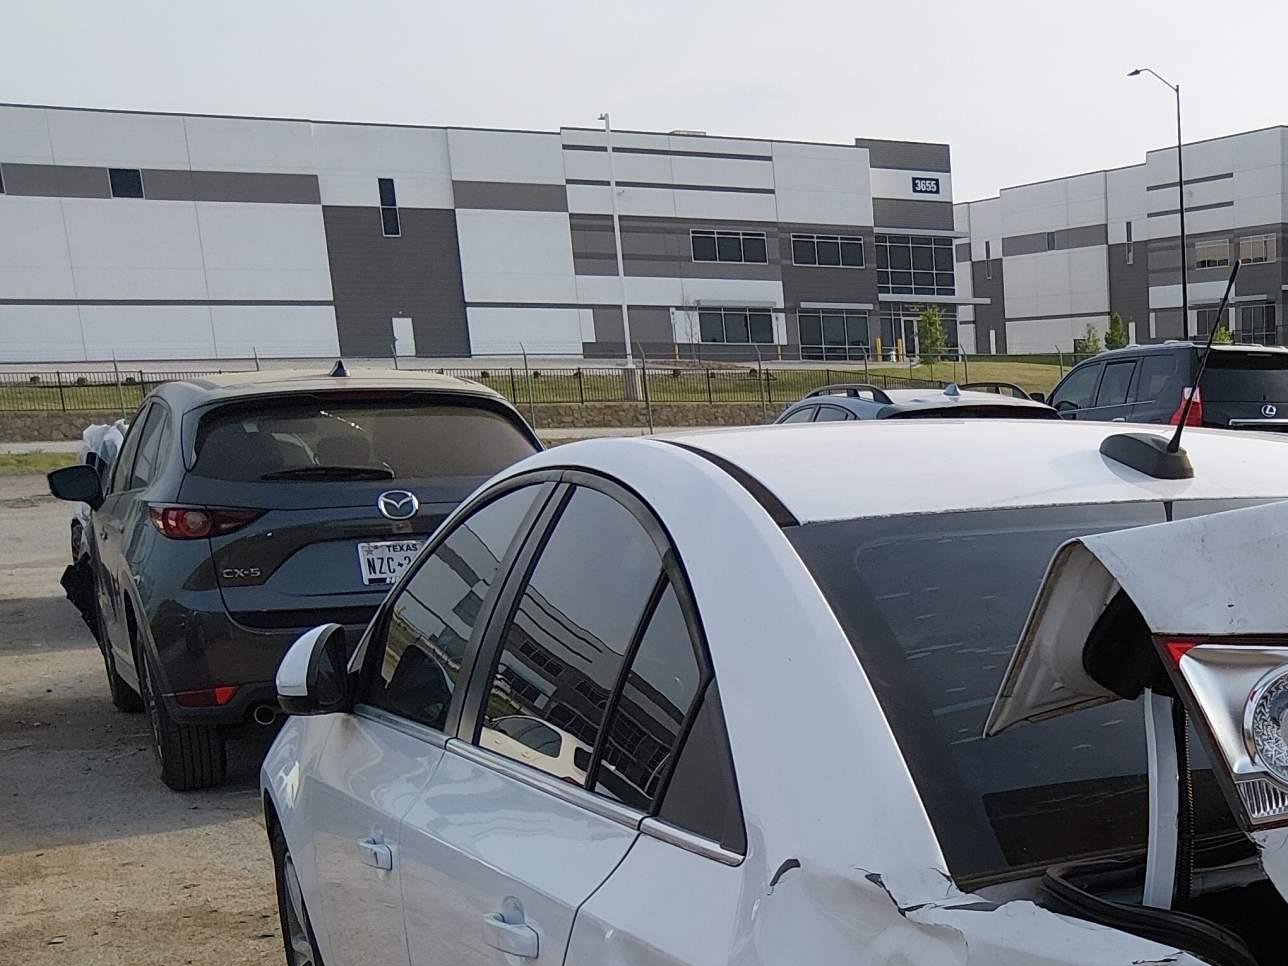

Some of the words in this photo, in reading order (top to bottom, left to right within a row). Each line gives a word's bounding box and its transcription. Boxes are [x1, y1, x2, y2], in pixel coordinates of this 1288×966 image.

[915, 180, 937, 191] 3655
[386, 543, 418, 553] TEXAS
[223, 567, 261, 578] CX-5
